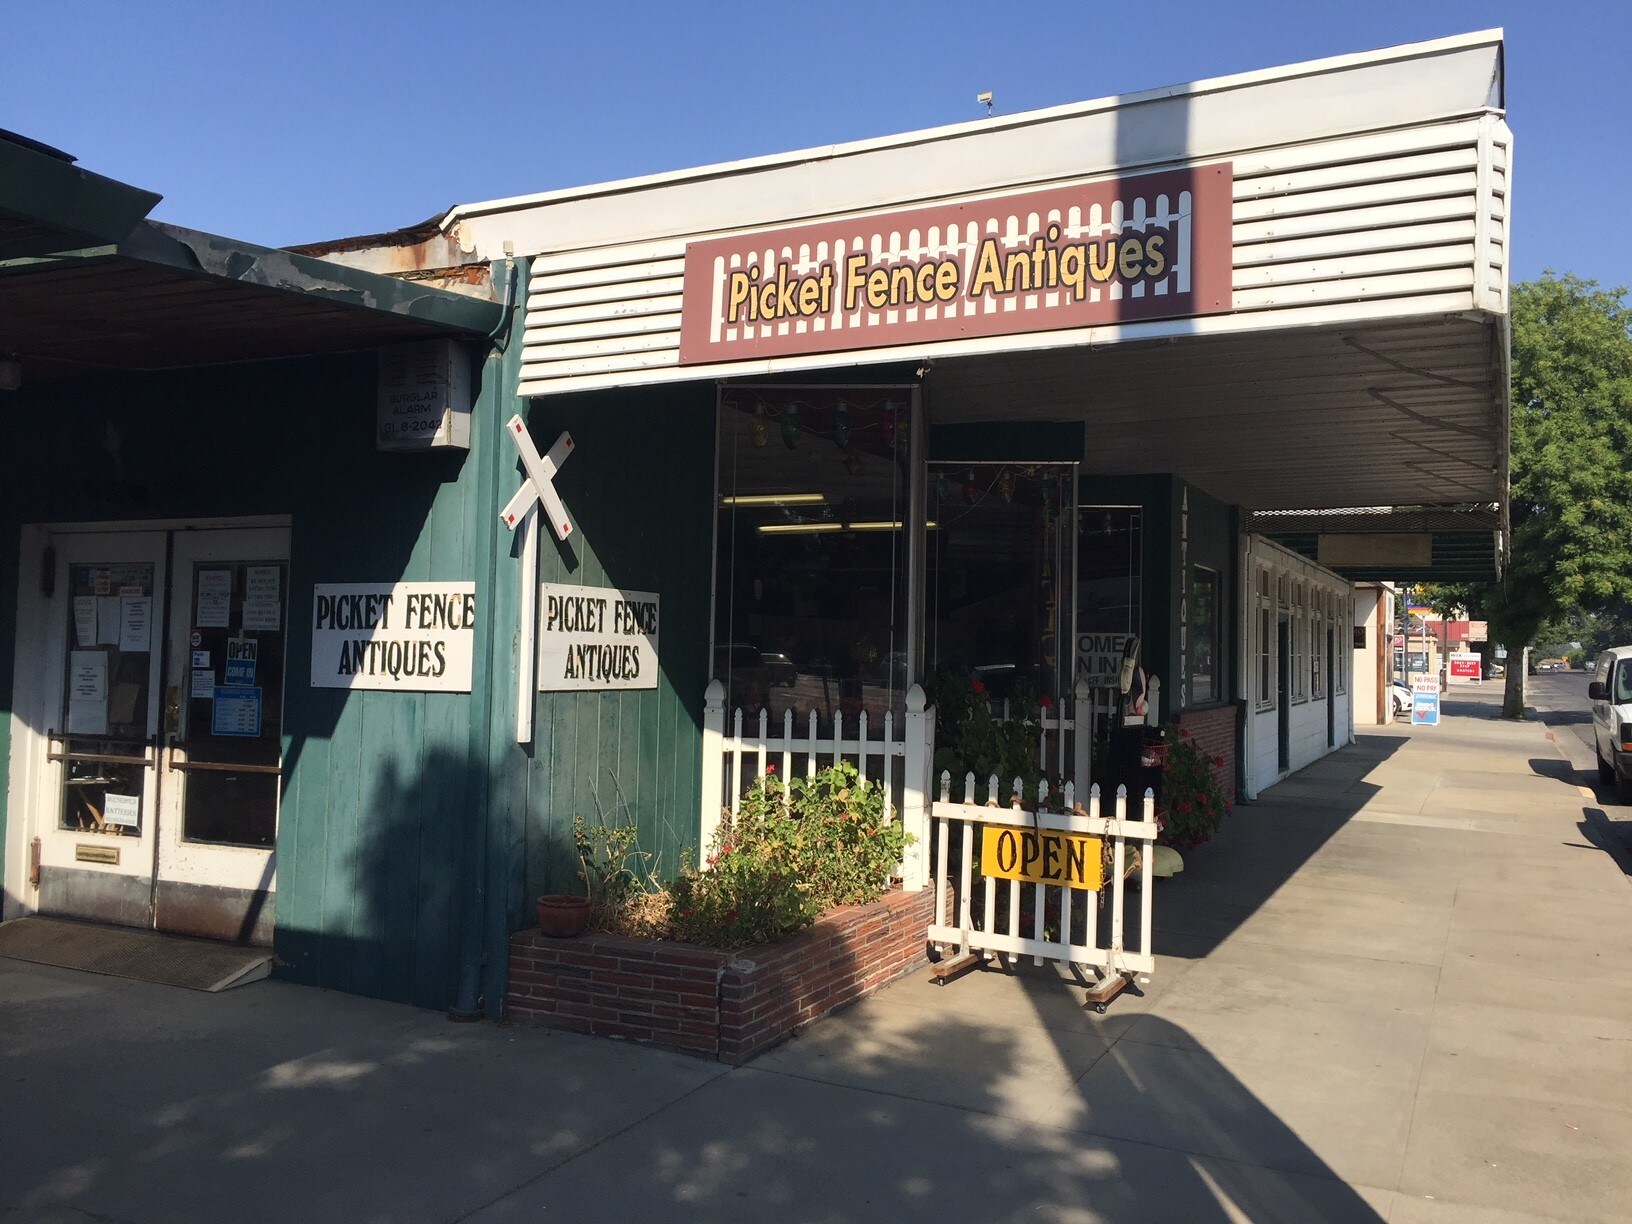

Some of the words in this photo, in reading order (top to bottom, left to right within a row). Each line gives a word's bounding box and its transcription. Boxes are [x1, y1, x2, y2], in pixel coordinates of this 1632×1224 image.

[728, 262, 833, 324] Picket
[844, 255, 959, 310] Fence
[970, 225, 1166, 300] Antiques
[389, 391, 438, 404] BURGLAR
[392, 404, 431, 415] ALARM
[316, 592, 394, 631] PICKET
[405, 592, 475, 631] FENCE
[546, 594, 607, 633] PICKET
[614, 598, 657, 635] FENCE
[229, 641, 257, 660] OPEN
[1078, 635, 1125, 653] OME
[227, 666, 245, 678] COME
[246, 667, 254, 678] IN
[337, 639, 446, 681] ANTIQUES
[564, 643, 640, 683] ANTIQUES
[1099, 656, 1117, 674] IN
[996, 830, 1087, 883] OPEN
